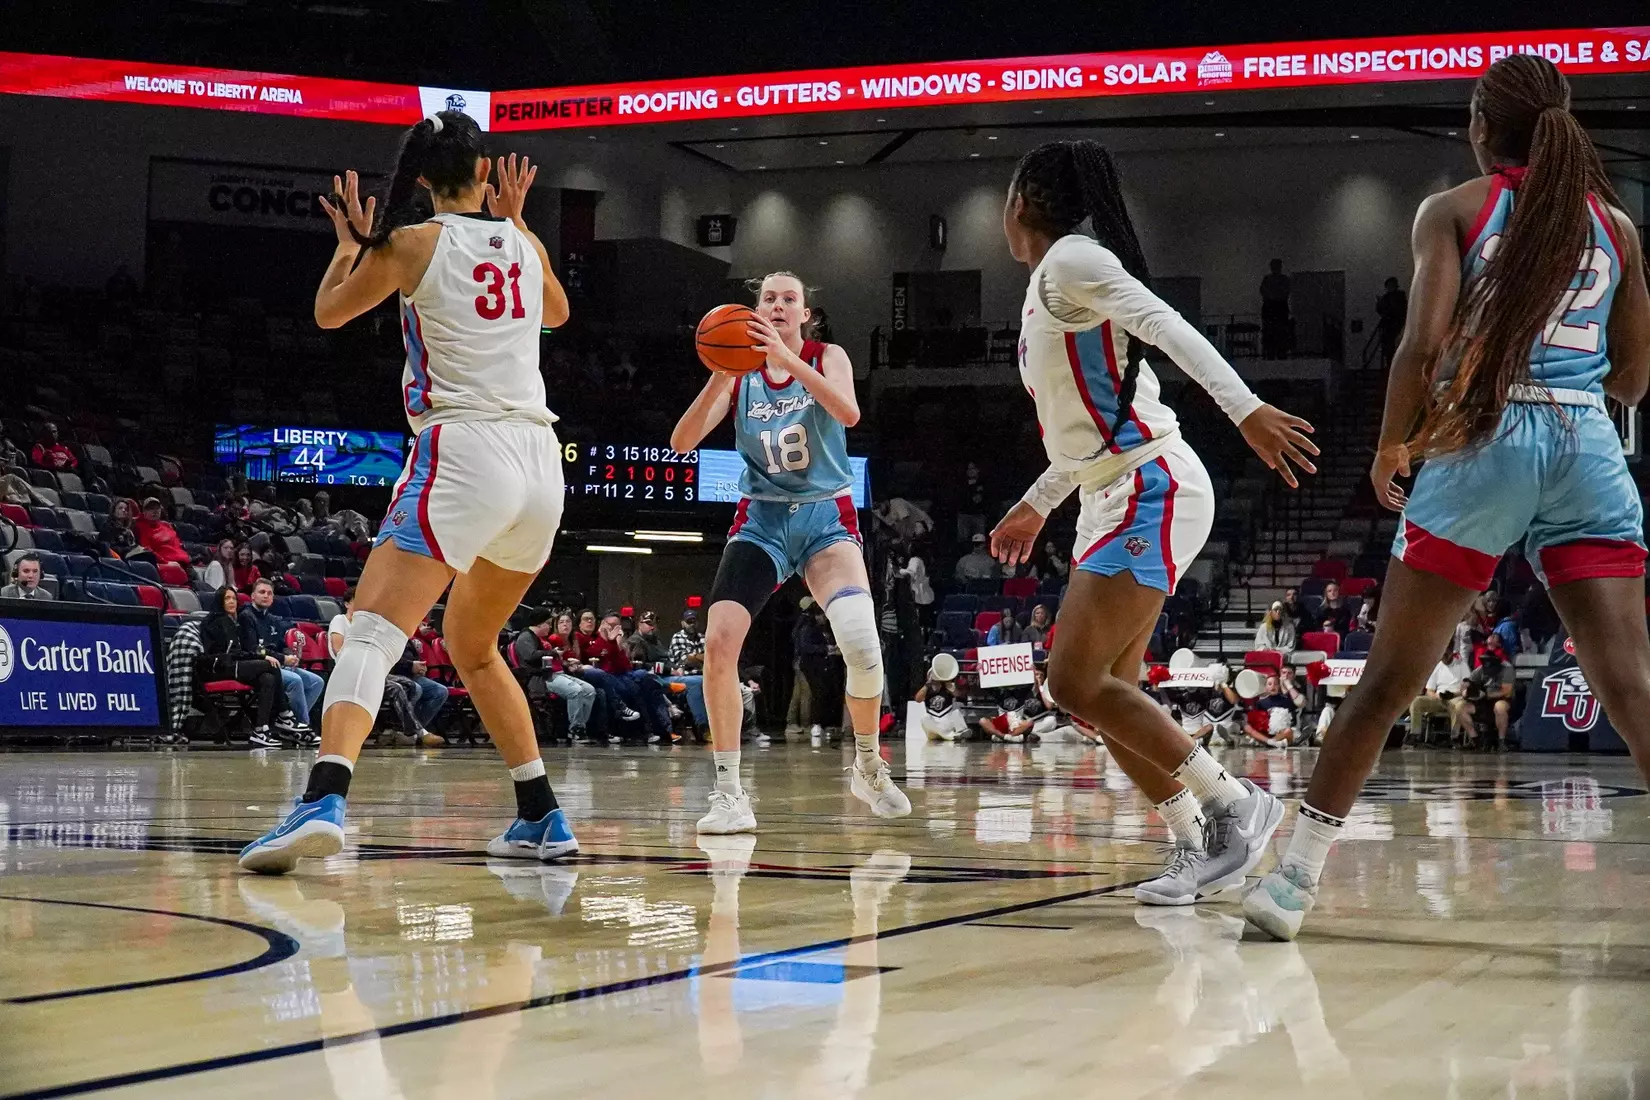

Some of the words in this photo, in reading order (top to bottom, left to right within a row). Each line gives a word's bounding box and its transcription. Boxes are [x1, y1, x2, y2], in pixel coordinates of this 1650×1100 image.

[1243, 55, 1307, 78] FREE
[1313, 46, 1483, 75] INSPECTIONS
[1600, 41, 1619, 62] &
[124, 76, 185, 94] WELCOME
[188, 81, 205, 95] TO
[207, 82, 257, 100] LIBERTY
[259, 87, 303, 104] ARENA
[495, 97, 613, 122] PERIMETER
[618, 89, 718, 114] ROOFING
[736, 81, 841, 107] GUTTERS
[861, 73, 981, 98] WINDOWS
[1001, 67, 1083, 92] SIDING
[1103, 61, 1187, 86] SOLAR
[473, 262, 525, 320] 31
[894, 287, 905, 331] OMEN
[274, 428, 347, 446] LIBERTY
[760, 423, 810, 474] 18
[294, 447, 325, 471] 44
[606, 445, 615, 460] 3
[622, 446, 639, 461] 15
[642, 447, 659, 461] 18
[661, 448, 679, 463] 22
[681, 449, 698, 464] 23
[378, 476, 386, 487] 4
[589, 465, 597, 476] F
[605, 464, 615, 479] 2
[627, 466, 634, 480] 1
[645, 466, 655, 481] 0
[665, 467, 675, 482] 0
[684, 468, 695, 483] 2
[585, 484, 601, 495] PT
[602, 483, 617, 498] 11
[624, 484, 634, 499] 2
[644, 485, 654, 499] 2
[664, 486, 674, 501] 5
[684, 487, 694, 501] 3
[20, 637, 91, 672] Carter
[96, 640, 155, 675] Bank
[981, 655, 1030, 676] DEFENSE
[20, 692, 48, 711] LIFE
[58, 692, 97, 711] LIVED
[107, 693, 140, 712] FULL
